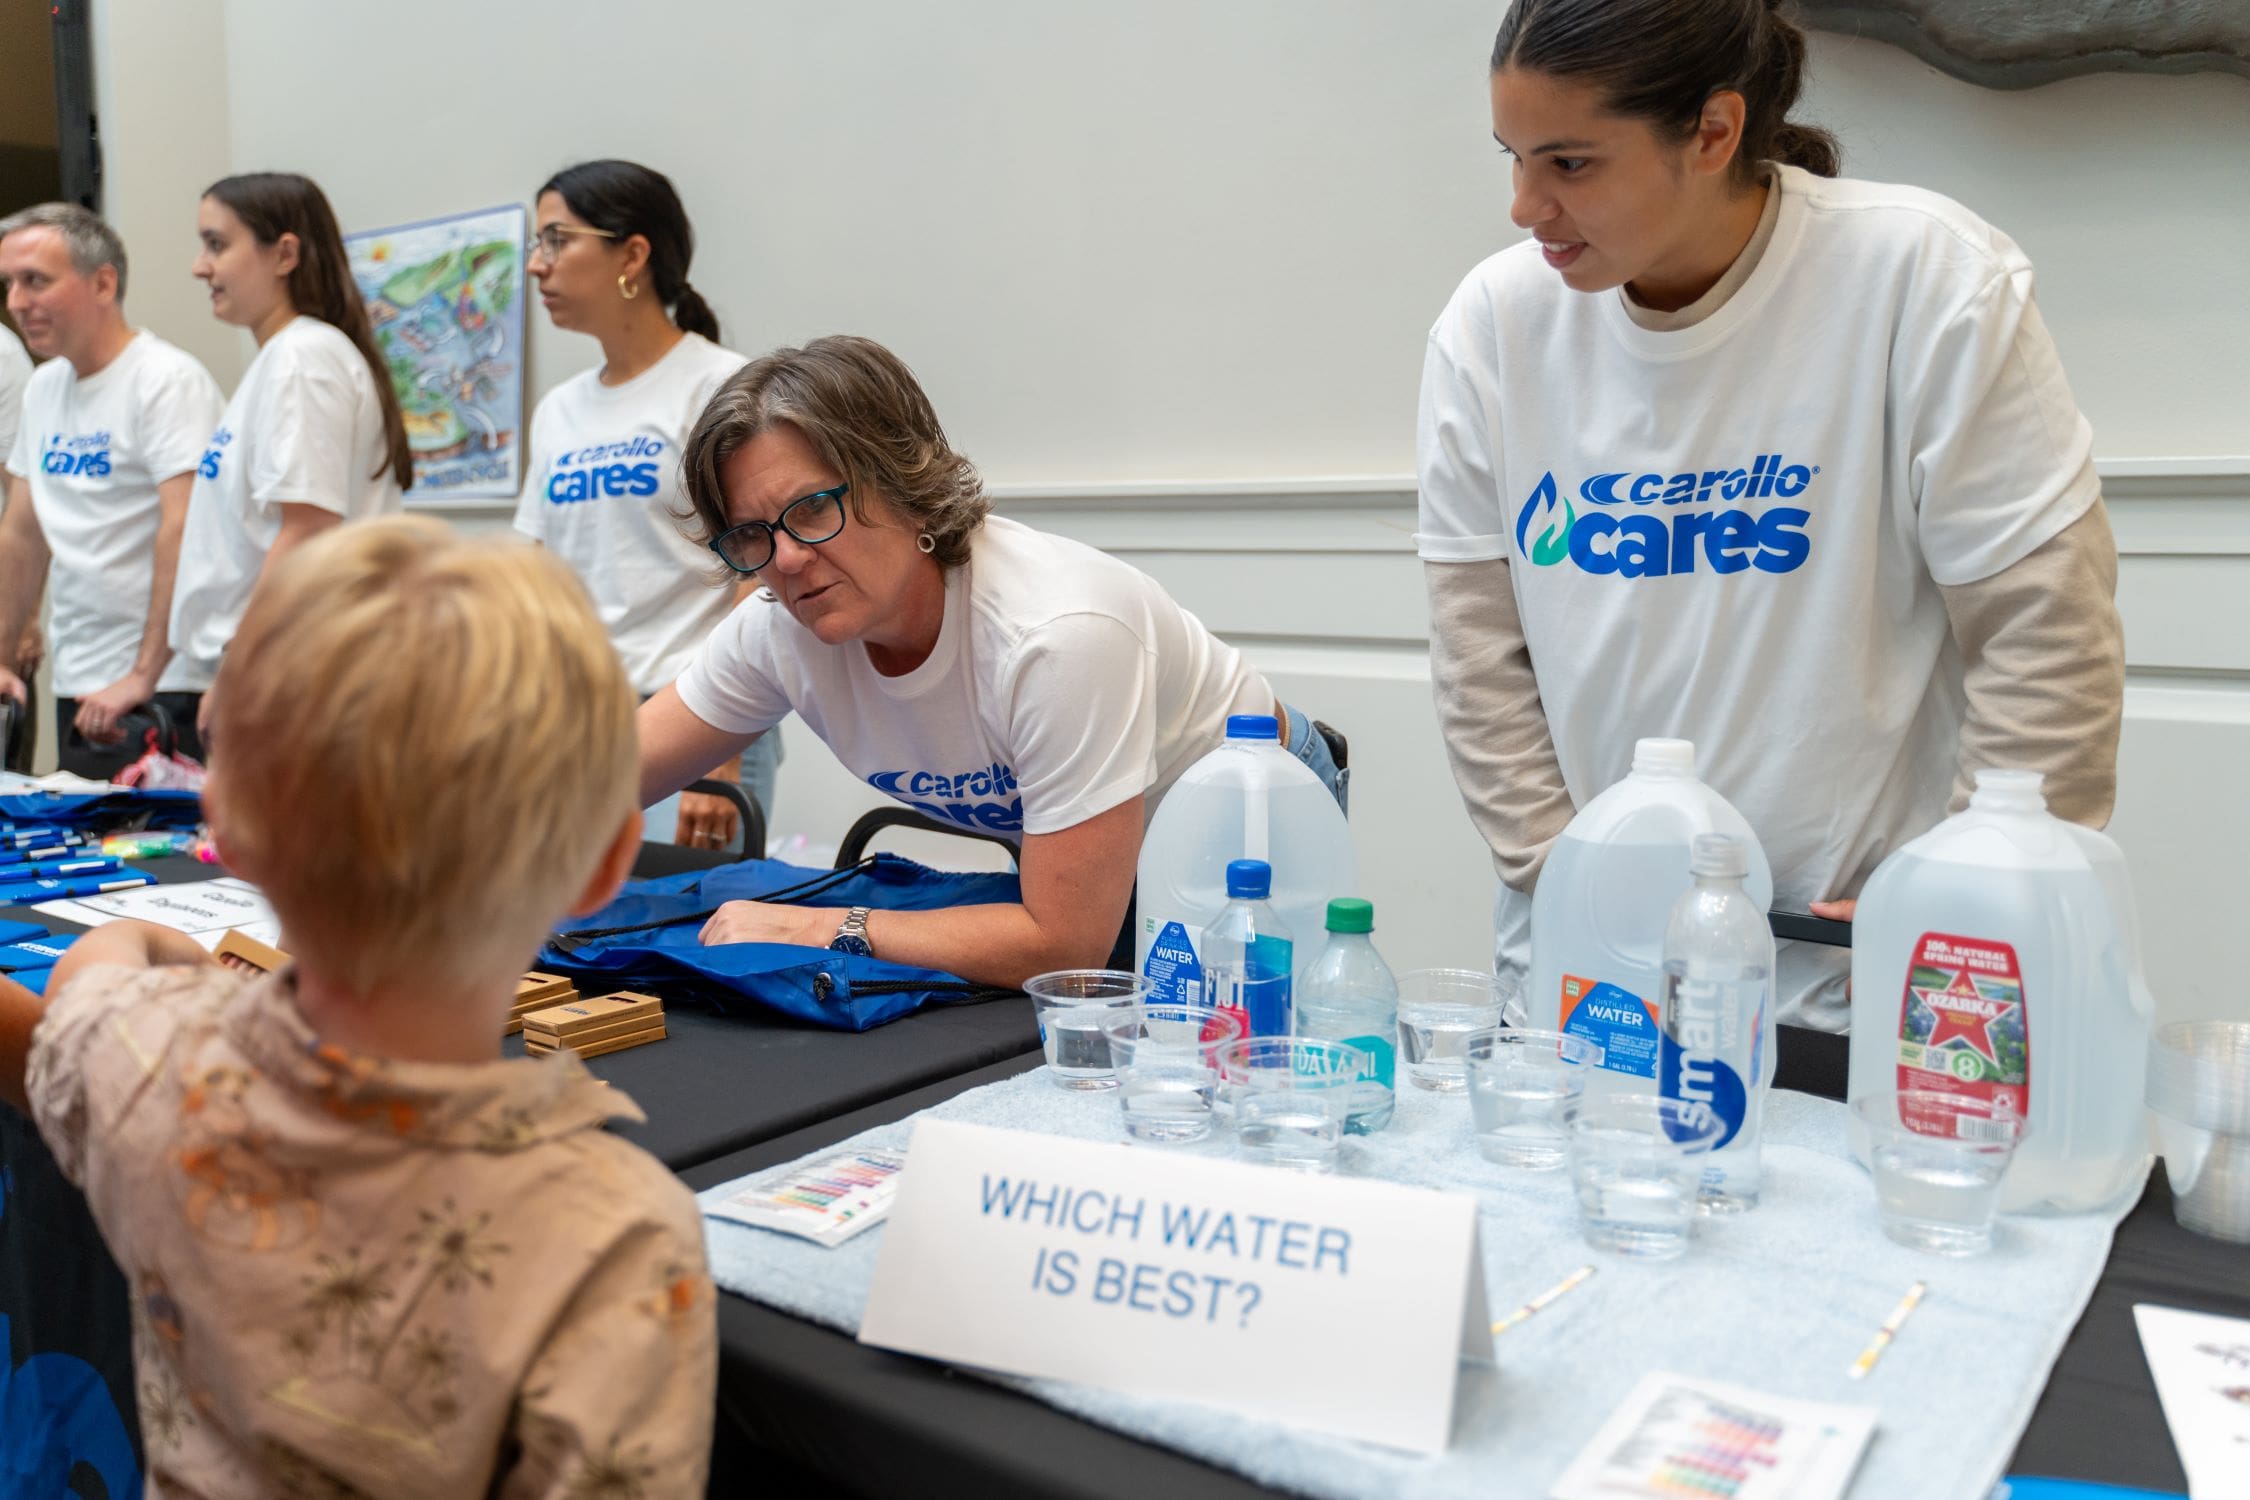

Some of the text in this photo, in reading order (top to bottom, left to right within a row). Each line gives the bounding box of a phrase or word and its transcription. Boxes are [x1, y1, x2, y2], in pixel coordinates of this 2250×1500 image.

[45, 451, 111, 477] cares
[548, 462, 659, 504] cares
[1568, 507, 1811, 579] cares
[1155, 945, 1193, 965] WATER
[1923, 951, 2010, 973] SPRING WATER
[1953, 946, 2007, 962] NATURAL
[1587, 1002, 1644, 1027] WATER
[1595, 997, 1636, 1011] DISTILLED
[1926, 991, 1997, 1017] OZARKA
[1675, 979, 1717, 1132] smart
[982, 1172, 1353, 1276] WHICH WATER
[1031, 1246, 1262, 1330] IS BEST?
